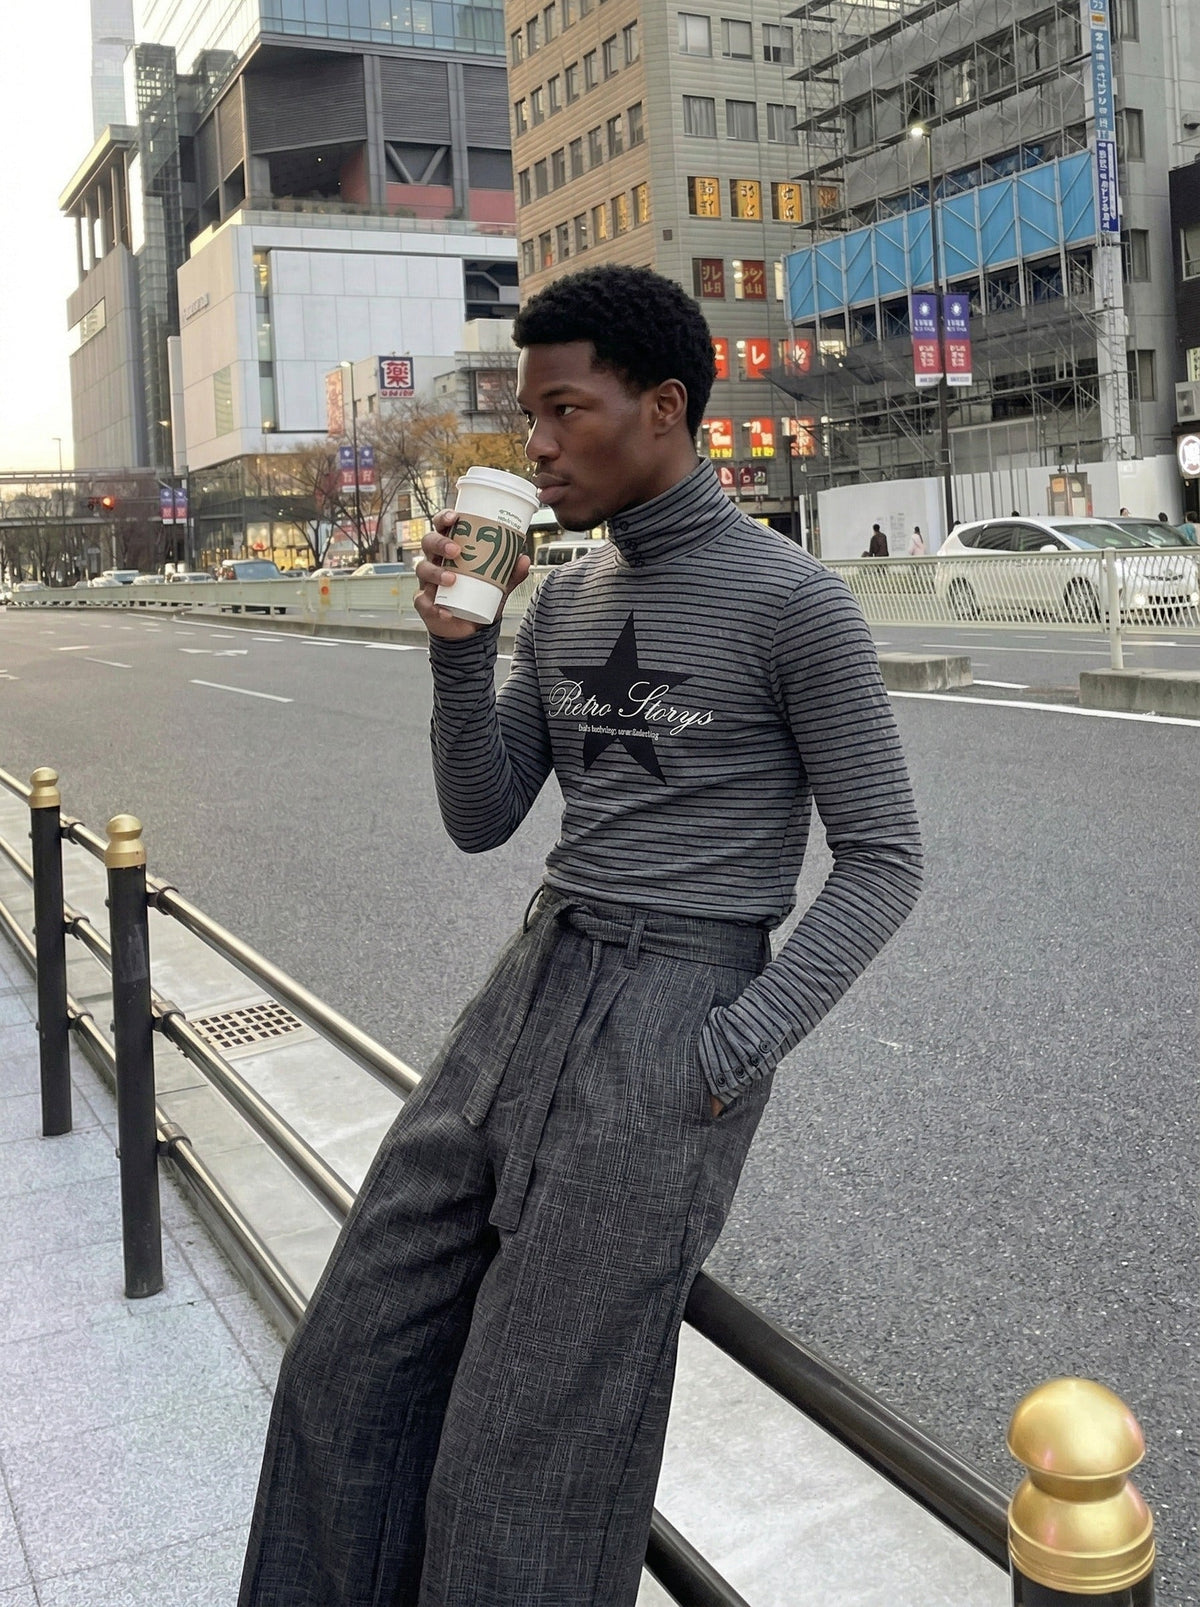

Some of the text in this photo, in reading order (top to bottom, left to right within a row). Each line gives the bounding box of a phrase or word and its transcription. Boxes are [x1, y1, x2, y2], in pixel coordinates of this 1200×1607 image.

[382, 361, 410, 387] 薬
[548, 679, 714, 736] Retro Storys
